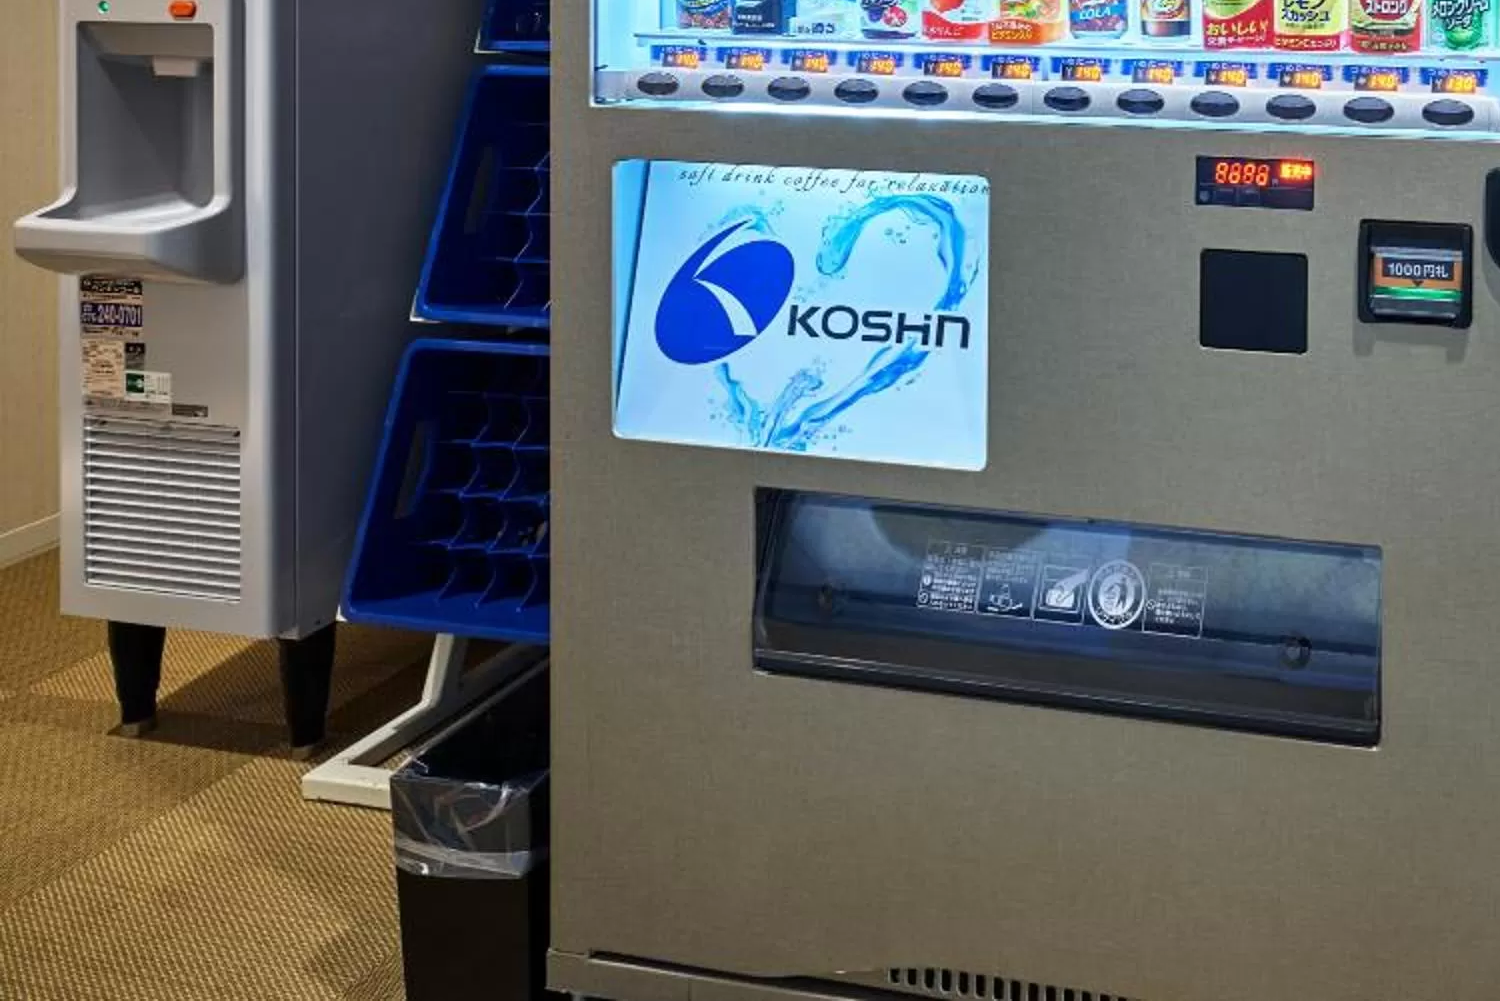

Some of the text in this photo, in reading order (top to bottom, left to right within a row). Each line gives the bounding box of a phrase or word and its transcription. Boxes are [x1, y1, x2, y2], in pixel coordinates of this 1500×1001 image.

[1079, 7, 1111, 20] COLA
[1365, 0, 1409, 15] ストロング
[1281, 10, 1330, 23] スカッシュ
[1446, 15, 1472, 30] ソーダ
[721, 166, 775, 185] drink
[783, 169, 839, 192] coffee
[1387, 262, 1449, 280] 1000円札
